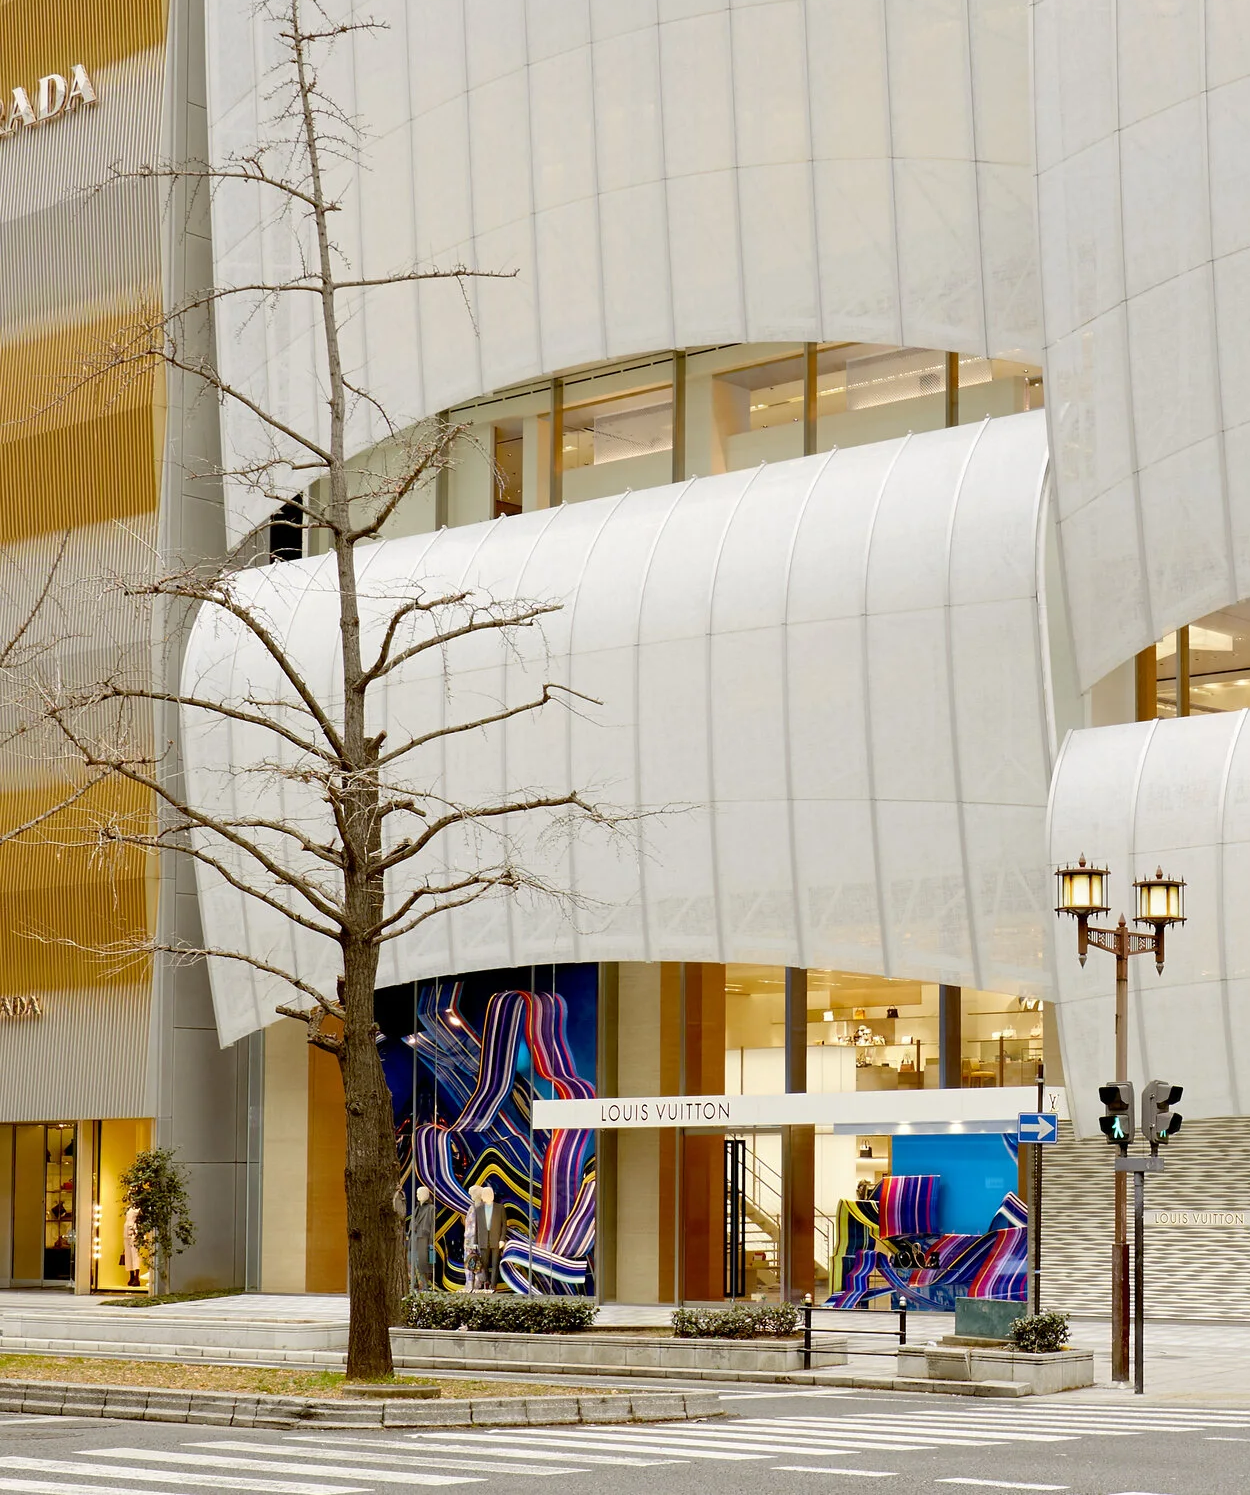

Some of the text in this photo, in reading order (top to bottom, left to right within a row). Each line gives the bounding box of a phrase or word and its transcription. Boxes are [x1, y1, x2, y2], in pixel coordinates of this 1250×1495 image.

[601, 1102, 730, 1122] LOUIS VUITTON
[1154, 1212, 1244, 1225] LOUIS VUITTON
